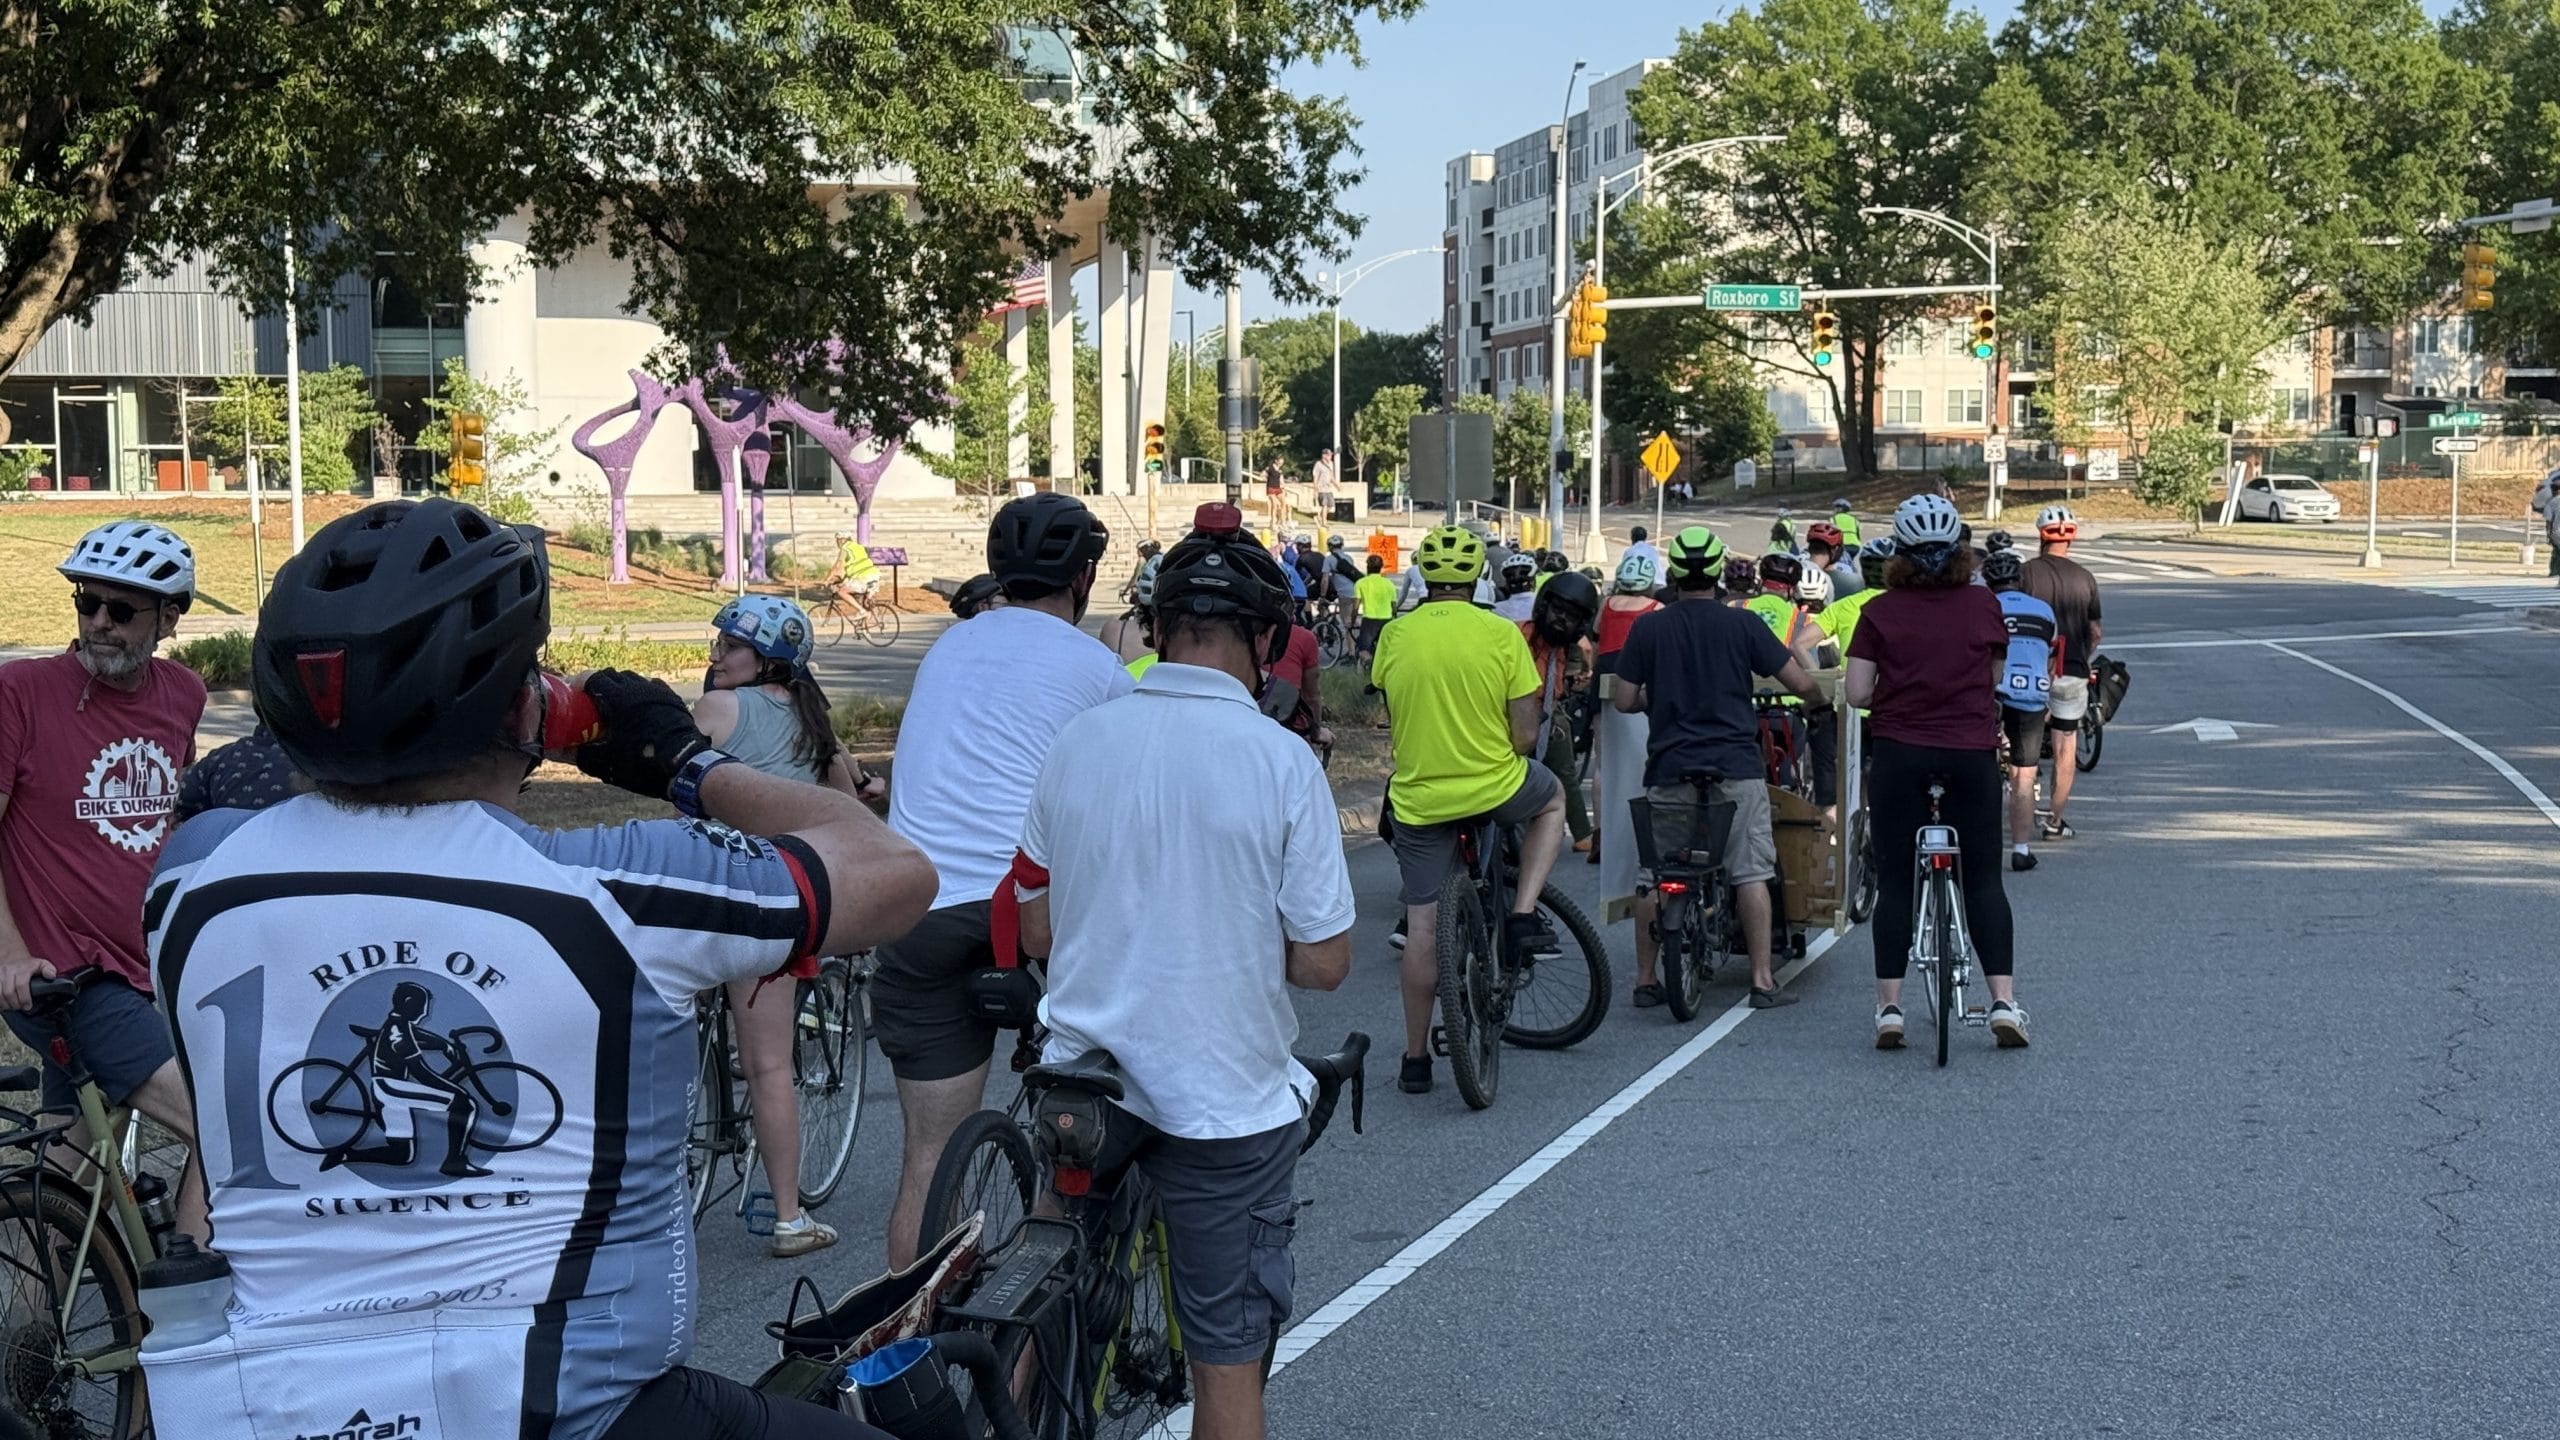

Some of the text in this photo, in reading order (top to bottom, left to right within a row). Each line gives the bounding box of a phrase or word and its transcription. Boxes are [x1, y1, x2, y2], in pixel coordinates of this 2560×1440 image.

[1711, 290, 1795, 306] Roxboro St
[1986, 448, 2003, 459] 25
[79, 801, 120, 816] BIKE
[309, 941, 506, 992] RIDE OF
[305, 1190, 531, 1218] SILENCE
